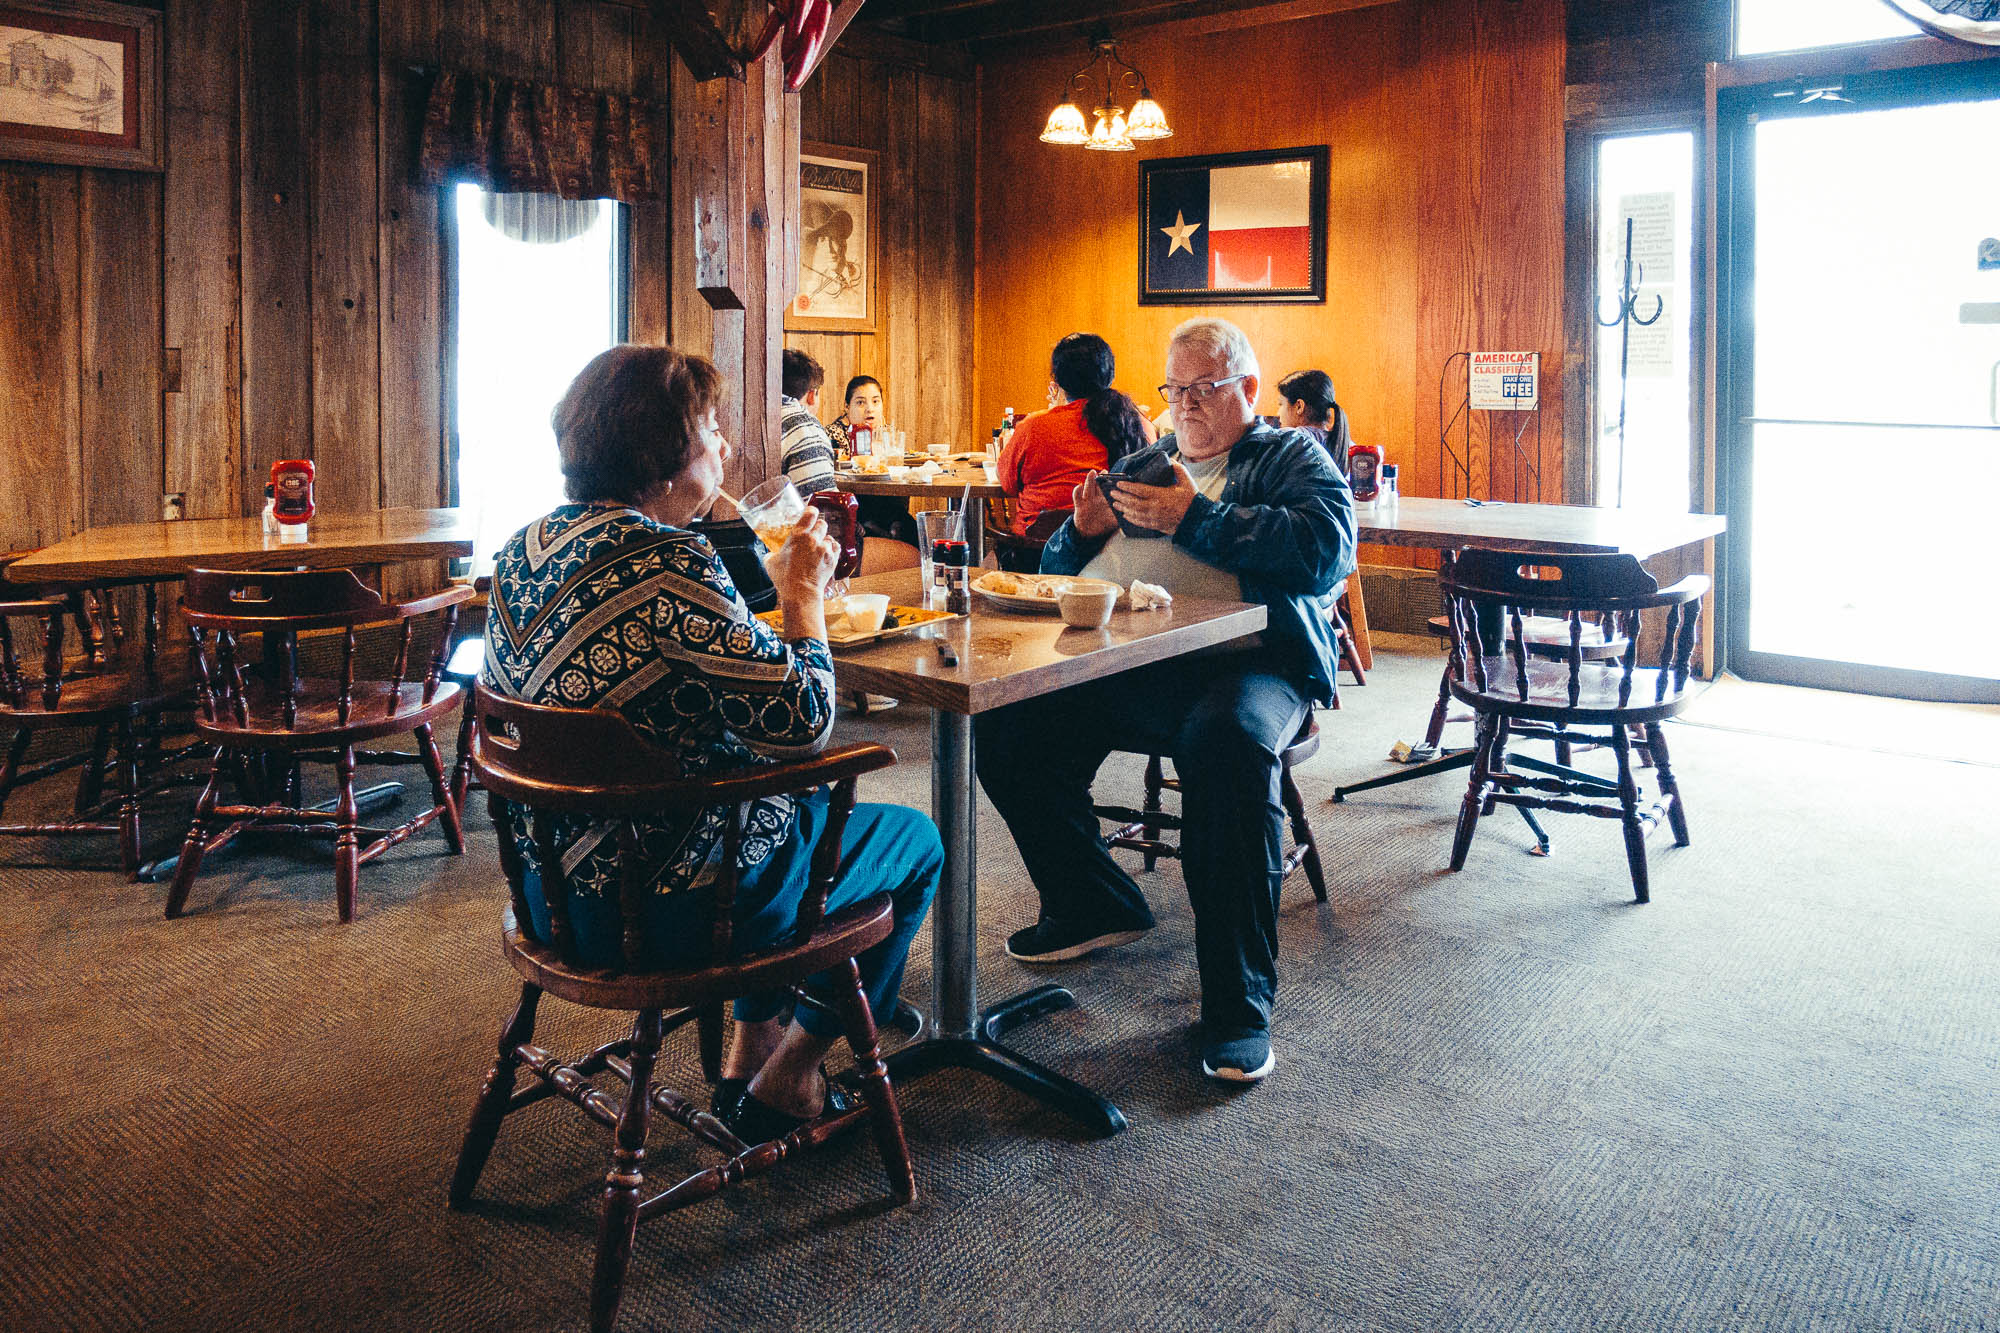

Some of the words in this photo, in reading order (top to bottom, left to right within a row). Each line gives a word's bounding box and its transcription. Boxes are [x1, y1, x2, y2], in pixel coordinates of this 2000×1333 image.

[1474, 354, 1533, 363] AMERICAN
[1474, 366, 1533, 374] CLASSIFIEDS
[1504, 383, 1532, 396] FREE
